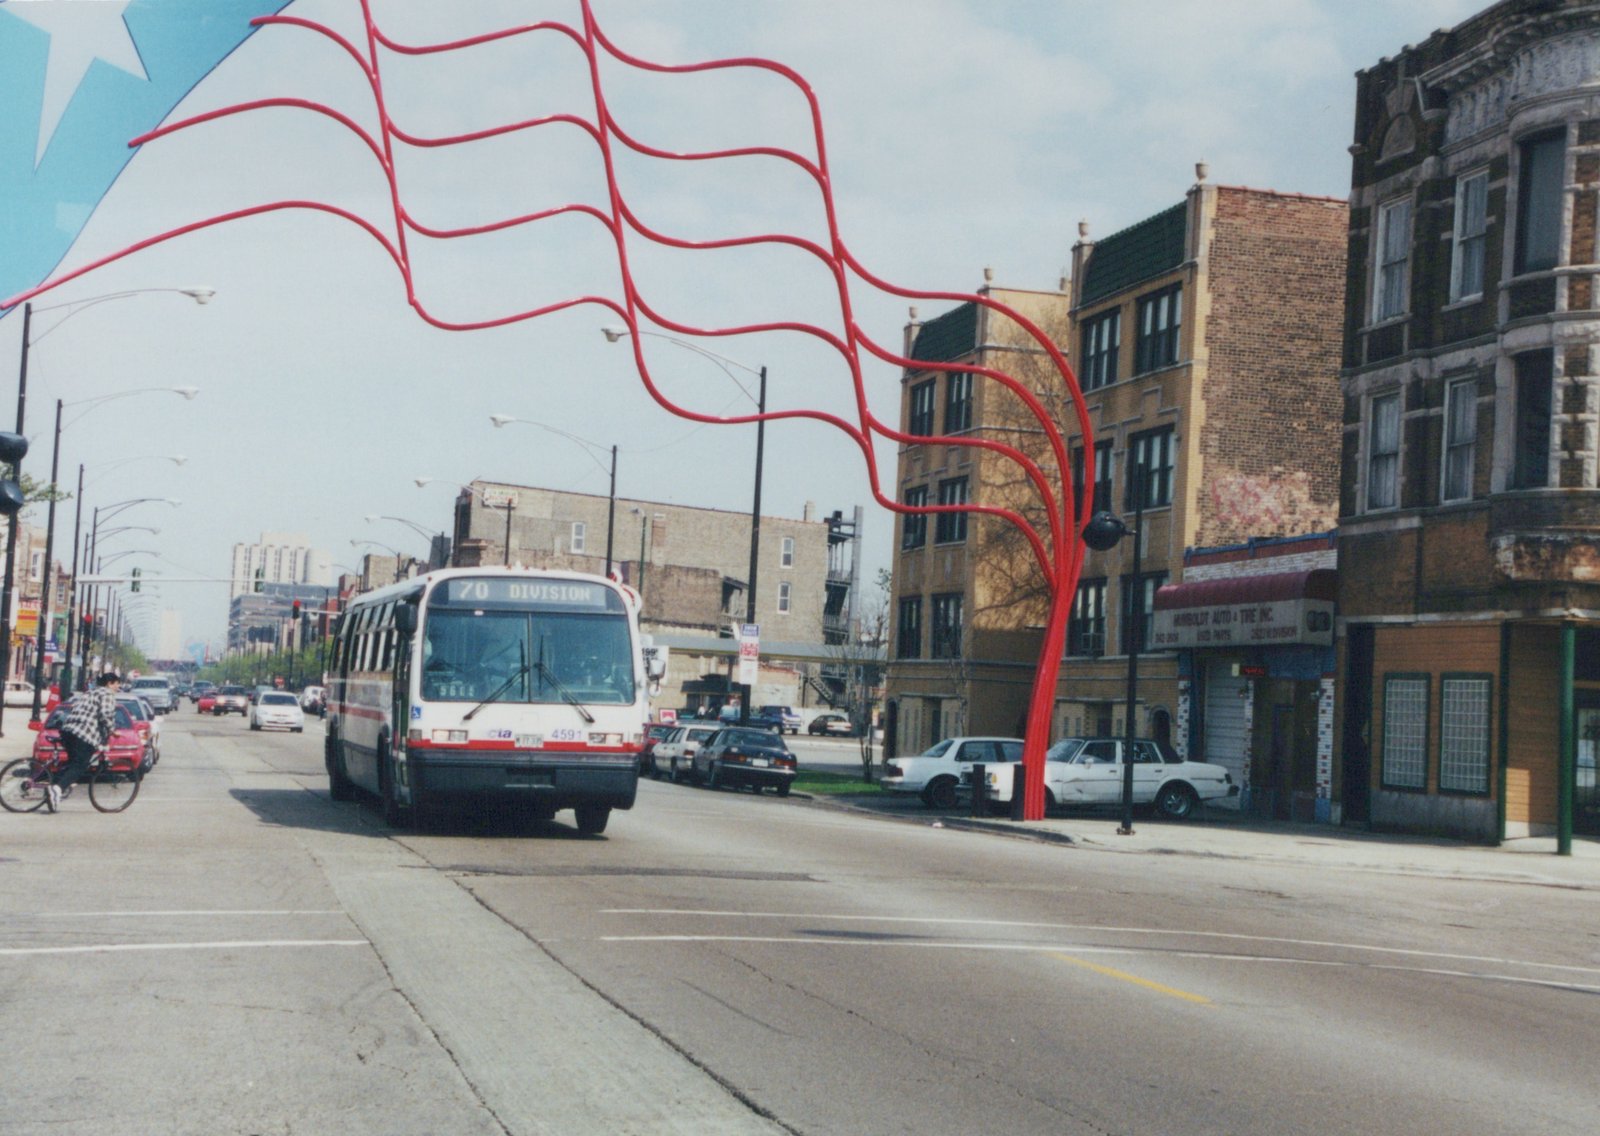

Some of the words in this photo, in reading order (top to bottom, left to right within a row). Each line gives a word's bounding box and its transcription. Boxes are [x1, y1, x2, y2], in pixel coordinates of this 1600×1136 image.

[459, 581, 489, 600] 70
[509, 584, 591, 601] DIVISION
[1212, 608, 1231, 624] AUTO
[1240, 607, 1257, 623] TIRE
[552, 729, 582, 741] 4591
